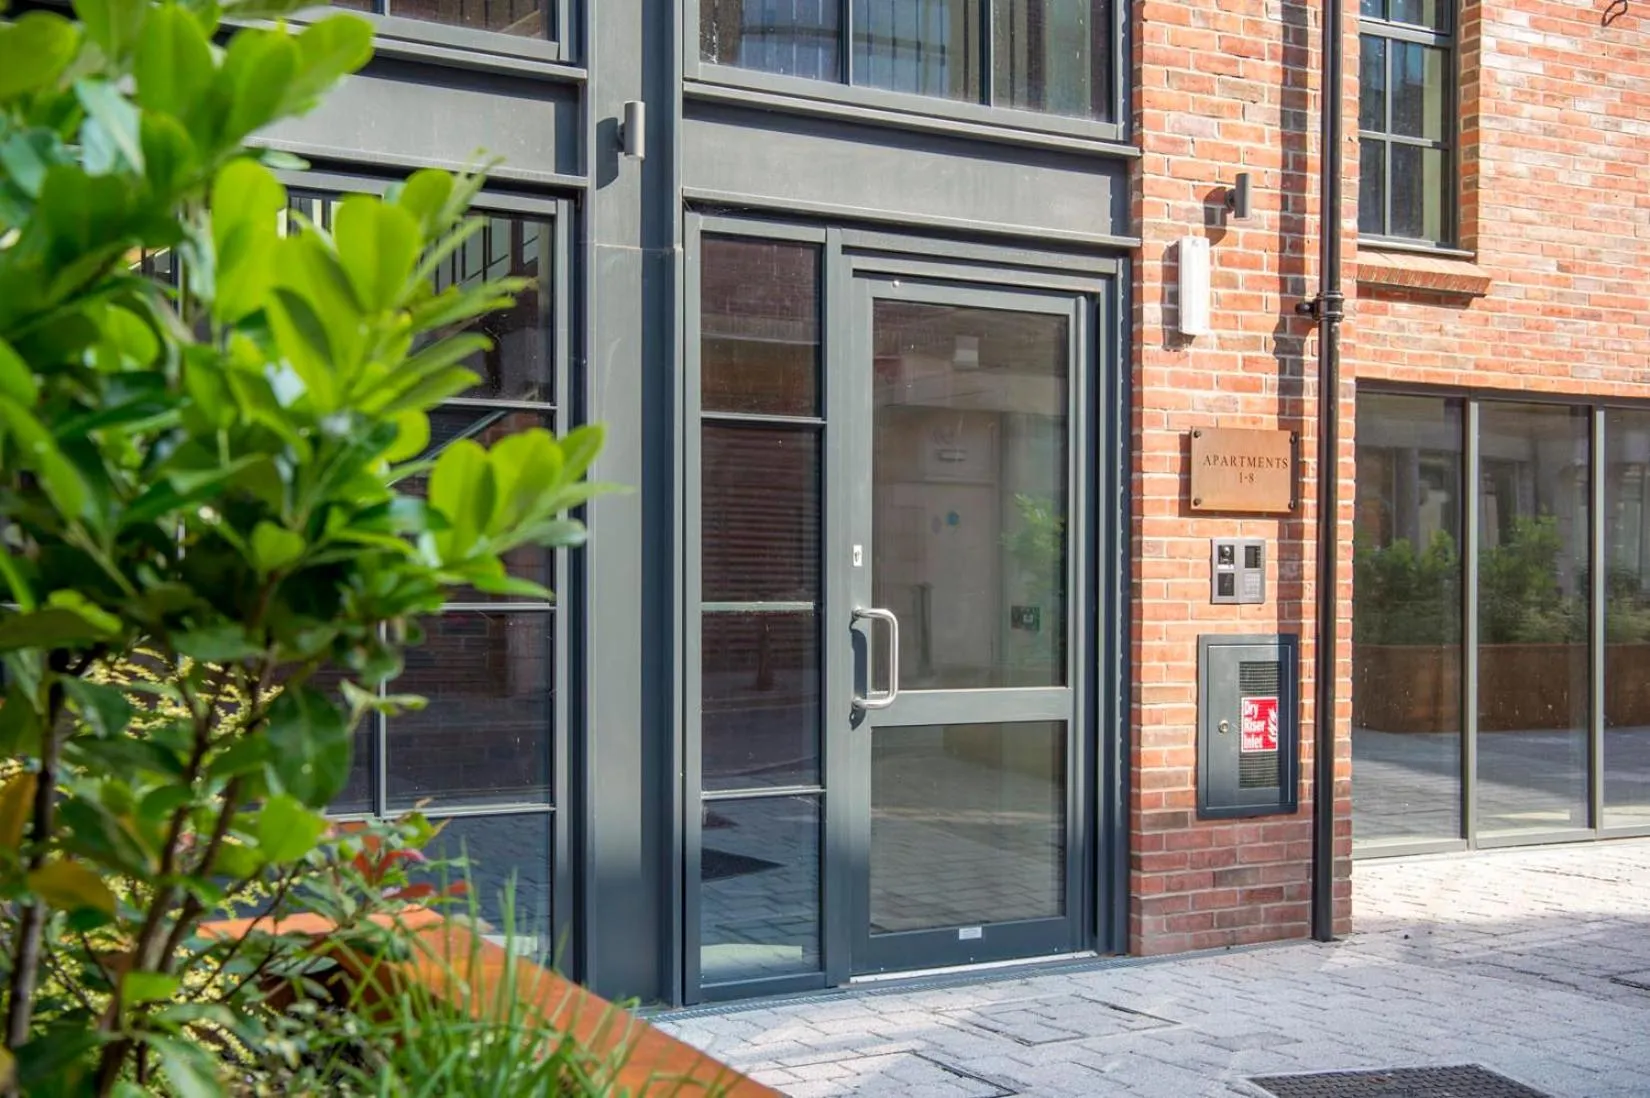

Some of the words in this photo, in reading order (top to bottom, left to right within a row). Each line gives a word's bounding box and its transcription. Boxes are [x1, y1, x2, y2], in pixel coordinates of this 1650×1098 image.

[1203, 454, 1289, 469] APARTMENTS
[1239, 472, 1255, 483] 1-8
[1244, 700, 1259, 719] Dry
[1244, 717, 1265, 733] Riser
[1244, 734, 1264, 749] Inlet
